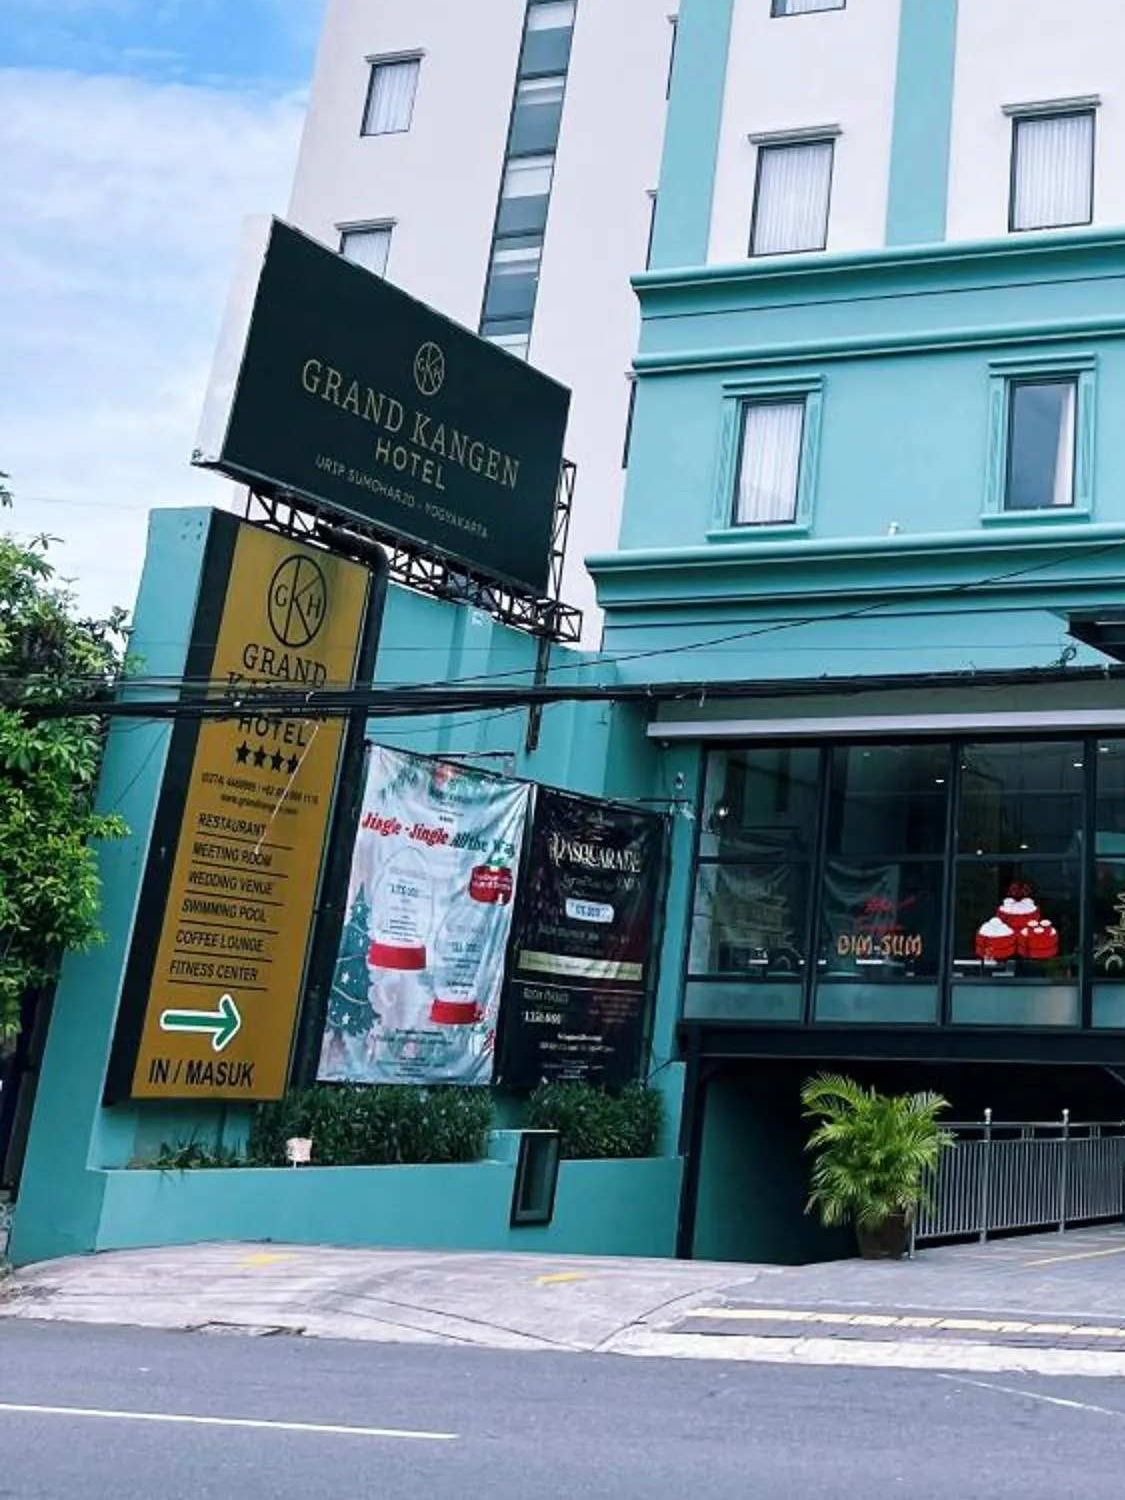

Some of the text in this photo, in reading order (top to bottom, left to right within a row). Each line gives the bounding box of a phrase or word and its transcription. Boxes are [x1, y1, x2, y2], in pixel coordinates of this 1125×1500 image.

[302, 359, 520, 489] GRAND KANGEN
[375, 437, 446, 490] HOTEL
[243, 643, 327, 688] GRAND
[238, 715, 305, 747] HOTEL
[198, 812, 267, 836] RESTAURANT
[409, 823, 449, 847] Jingle
[193, 841, 273, 867] MEETING ROOM
[189, 870, 273, 896] WEDDING VENUE
[182, 897, 267, 923] SWIMMING POOL
[175, 929, 264, 953] COFFEE LOUNGE
[837, 933, 923, 956] DIM-SUM
[169, 959, 259, 981] FITNESS CENTER
[148, 1058, 172, 1085] IN
[184, 1059, 256, 1088] MASUK
